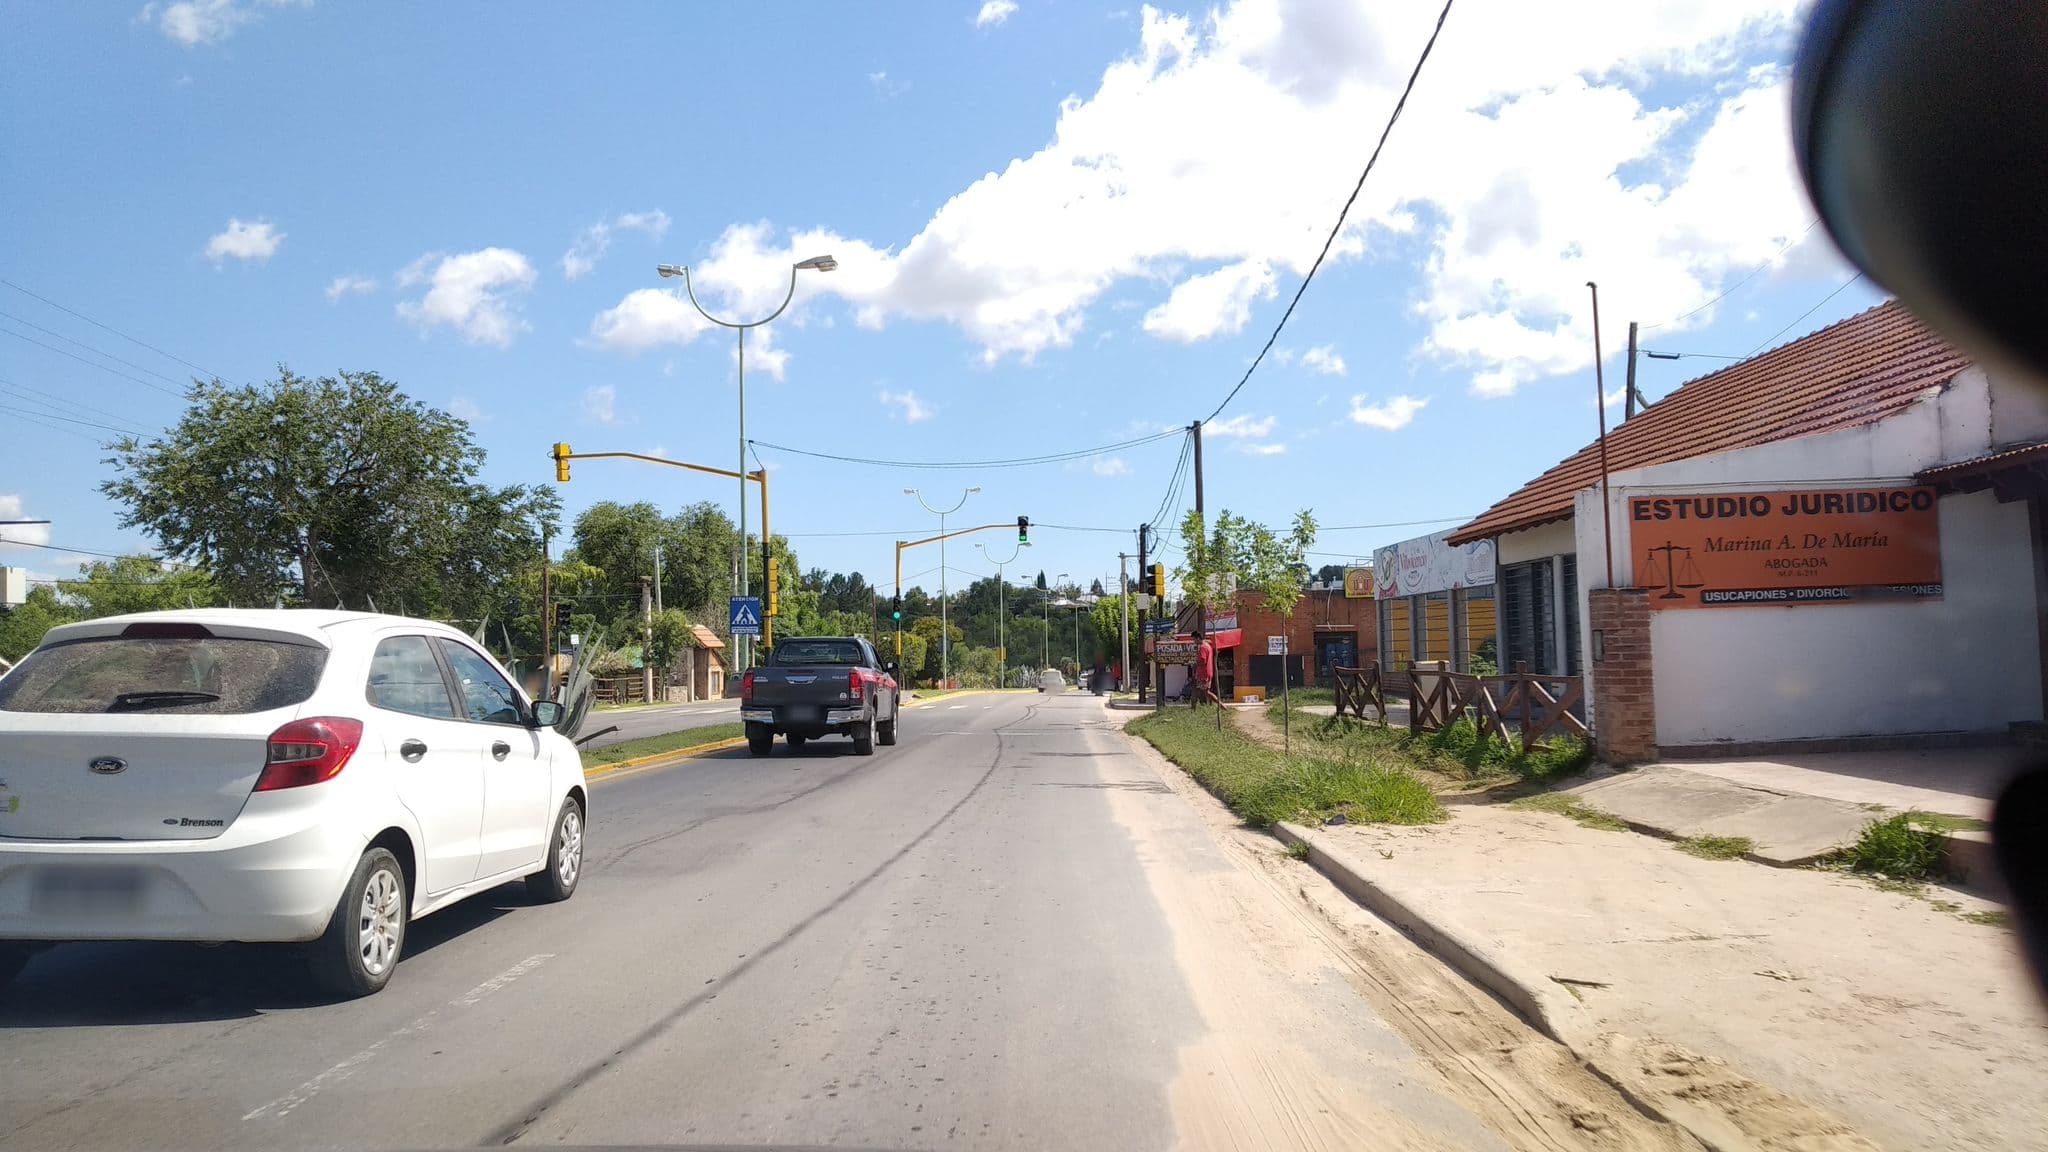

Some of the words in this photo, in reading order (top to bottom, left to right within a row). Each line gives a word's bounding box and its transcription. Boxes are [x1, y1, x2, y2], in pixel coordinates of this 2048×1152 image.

[1634, 496, 1771, 521] ESTUDIO
[1782, 490, 1933, 516] JURIDICO
[1704, 536, 1772, 553] Marina
[1776, 535, 1796, 550] A.
[1803, 533, 1827, 549] De
[1833, 531, 1889, 549] María
[1764, 557, 1828, 569] ABOGADA
[1705, 589, 1787, 602] USUCAPIONES
[94, 760, 116, 771] Ford
[180, 817, 224, 827] Brenson
